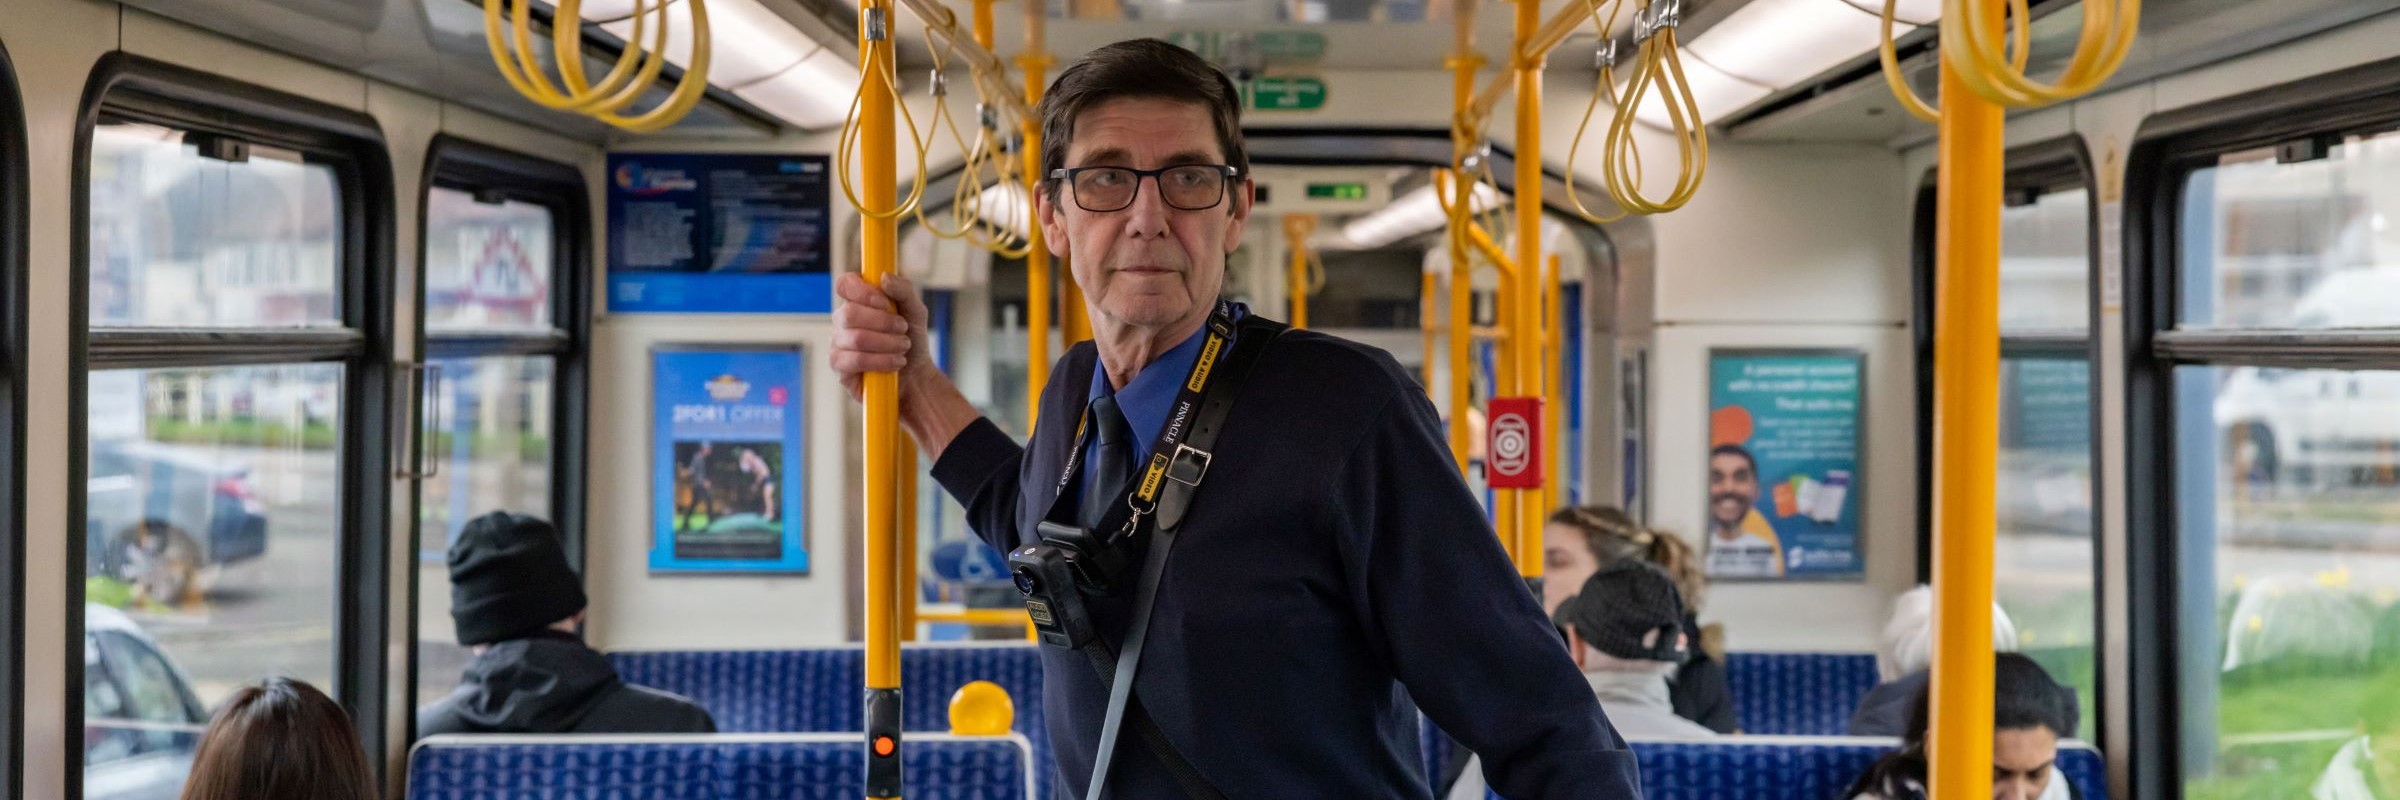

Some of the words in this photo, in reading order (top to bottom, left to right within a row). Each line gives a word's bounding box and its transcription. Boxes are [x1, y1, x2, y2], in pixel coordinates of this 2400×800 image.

[1205, 341, 1218, 361] VIDEO
[1192, 367, 1206, 389] AUDIO
[1165, 401, 1191, 444] PINNACLE
[1144, 471, 1158, 495] VIDEO
